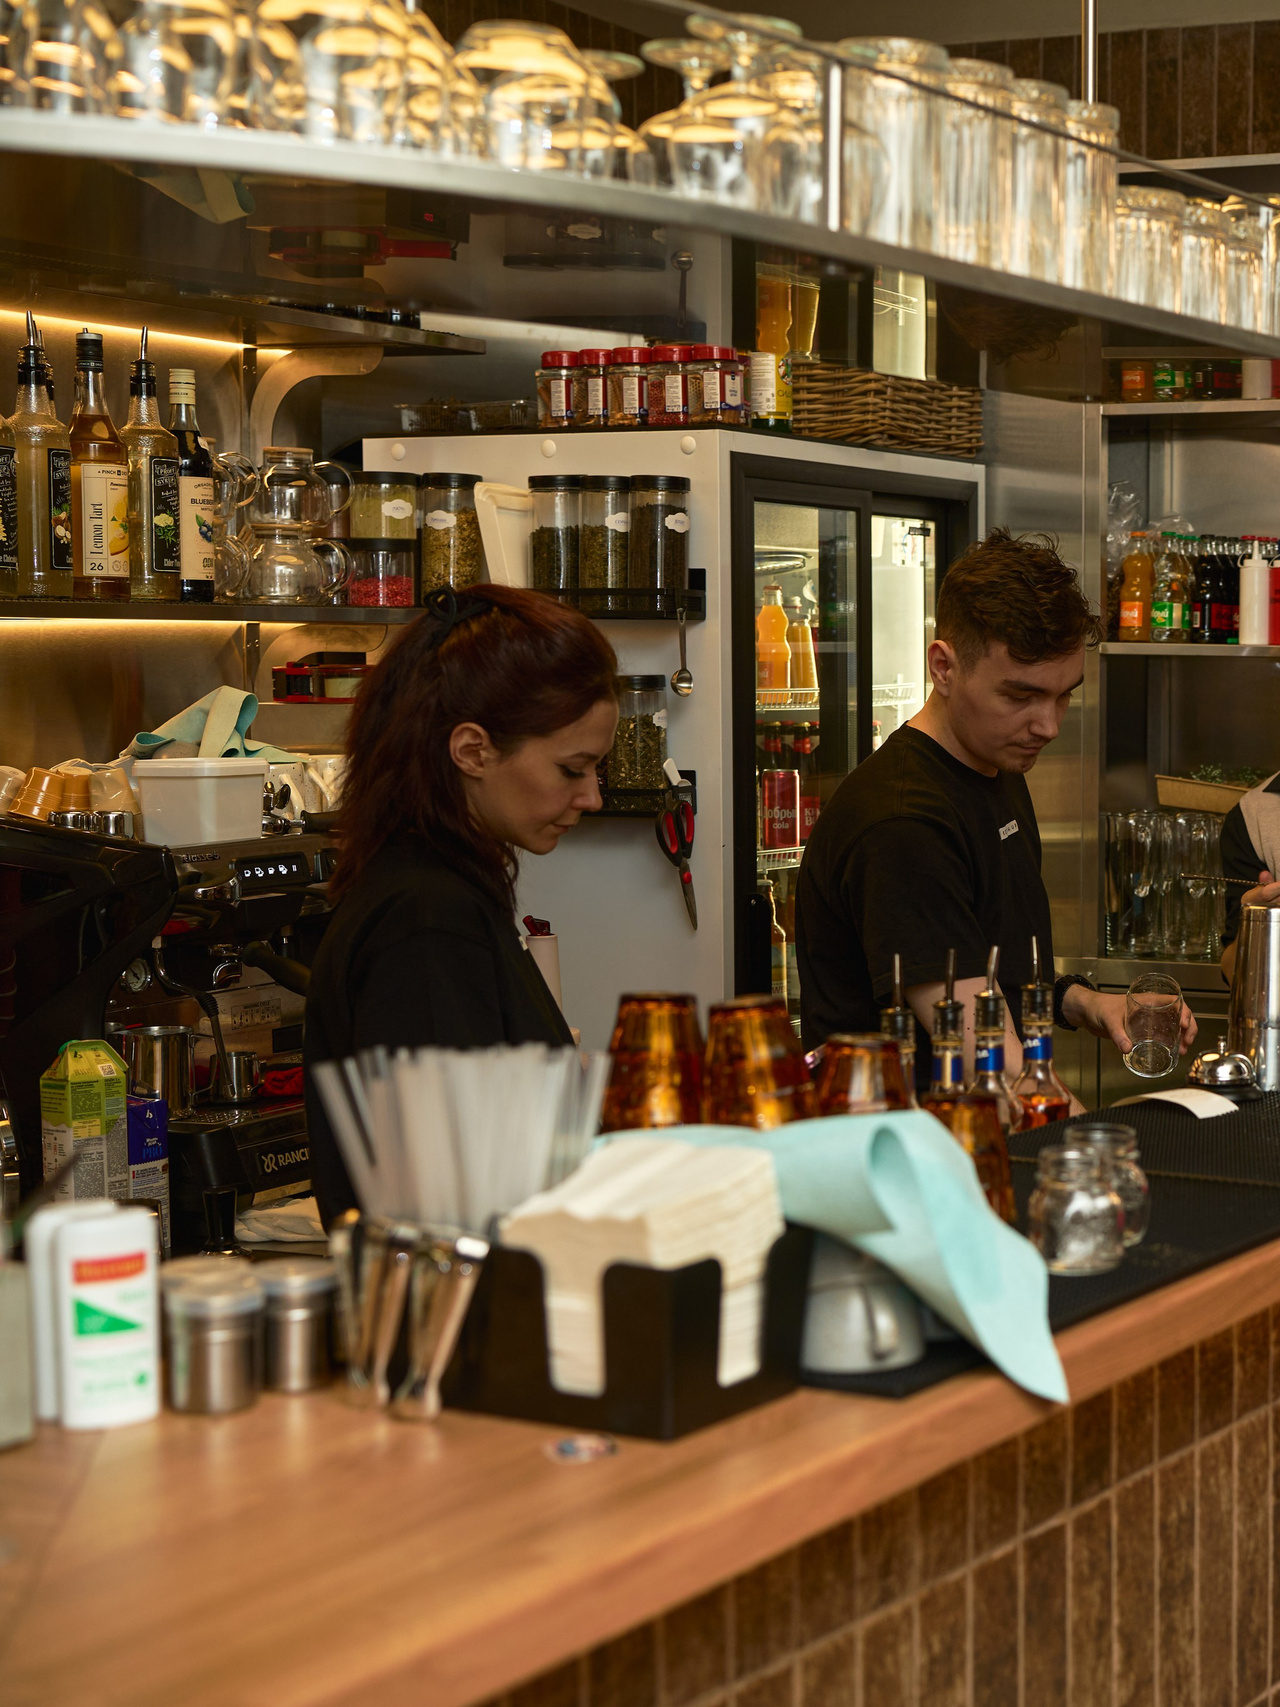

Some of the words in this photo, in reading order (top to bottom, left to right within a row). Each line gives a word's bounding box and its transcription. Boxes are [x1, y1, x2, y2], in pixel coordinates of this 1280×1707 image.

[89, 502, 103, 521] Tart
[90, 524, 104, 555] Lemon
[90, 562, 104, 571] 26
[772, 821, 790, 829] cola
